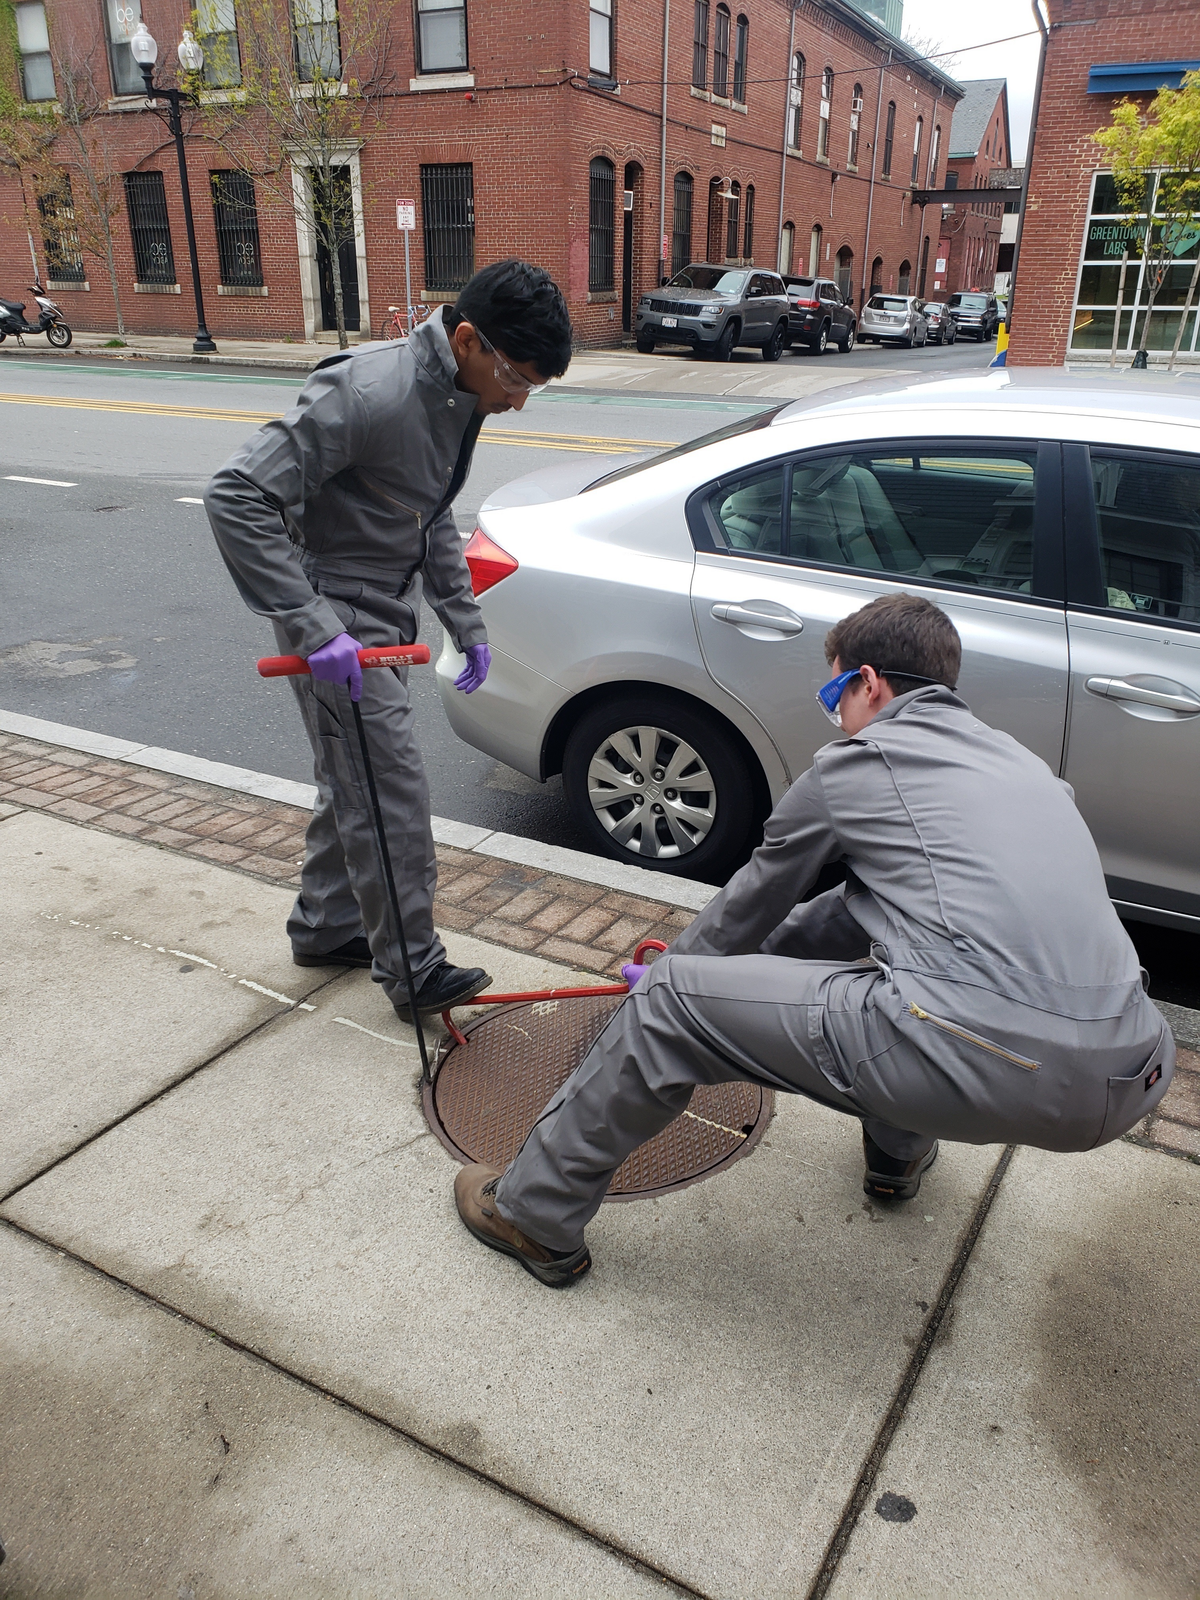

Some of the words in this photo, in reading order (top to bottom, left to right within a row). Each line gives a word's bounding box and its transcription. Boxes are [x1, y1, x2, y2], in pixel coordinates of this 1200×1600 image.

[114, 0, 134, 23] be
[1090, 226, 1147, 240] GREENTOWN
[1103, 241, 1127, 255] LABS
[379, 654, 413, 663] BULLY
